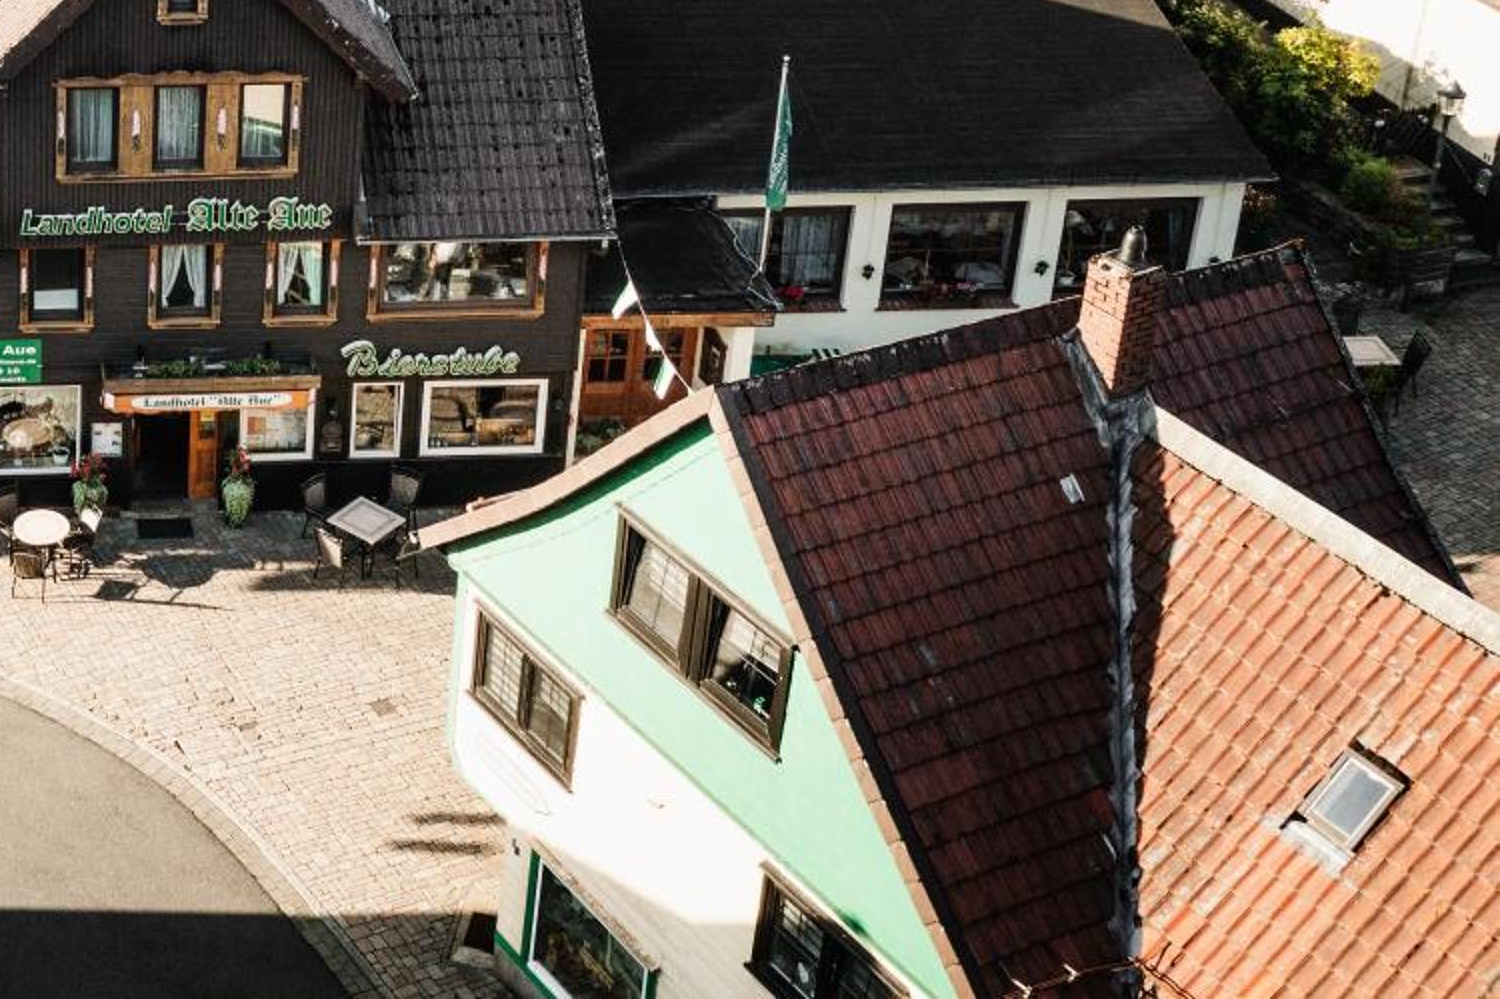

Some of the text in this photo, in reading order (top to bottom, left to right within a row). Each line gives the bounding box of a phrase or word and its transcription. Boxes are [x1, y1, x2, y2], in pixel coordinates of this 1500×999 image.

[19, 196, 333, 236] Landhotel Alte Aue
[2, 344, 37, 356] Aue
[340, 339, 521, 377] Bierstube
[143, 396, 205, 407] Landhotel
